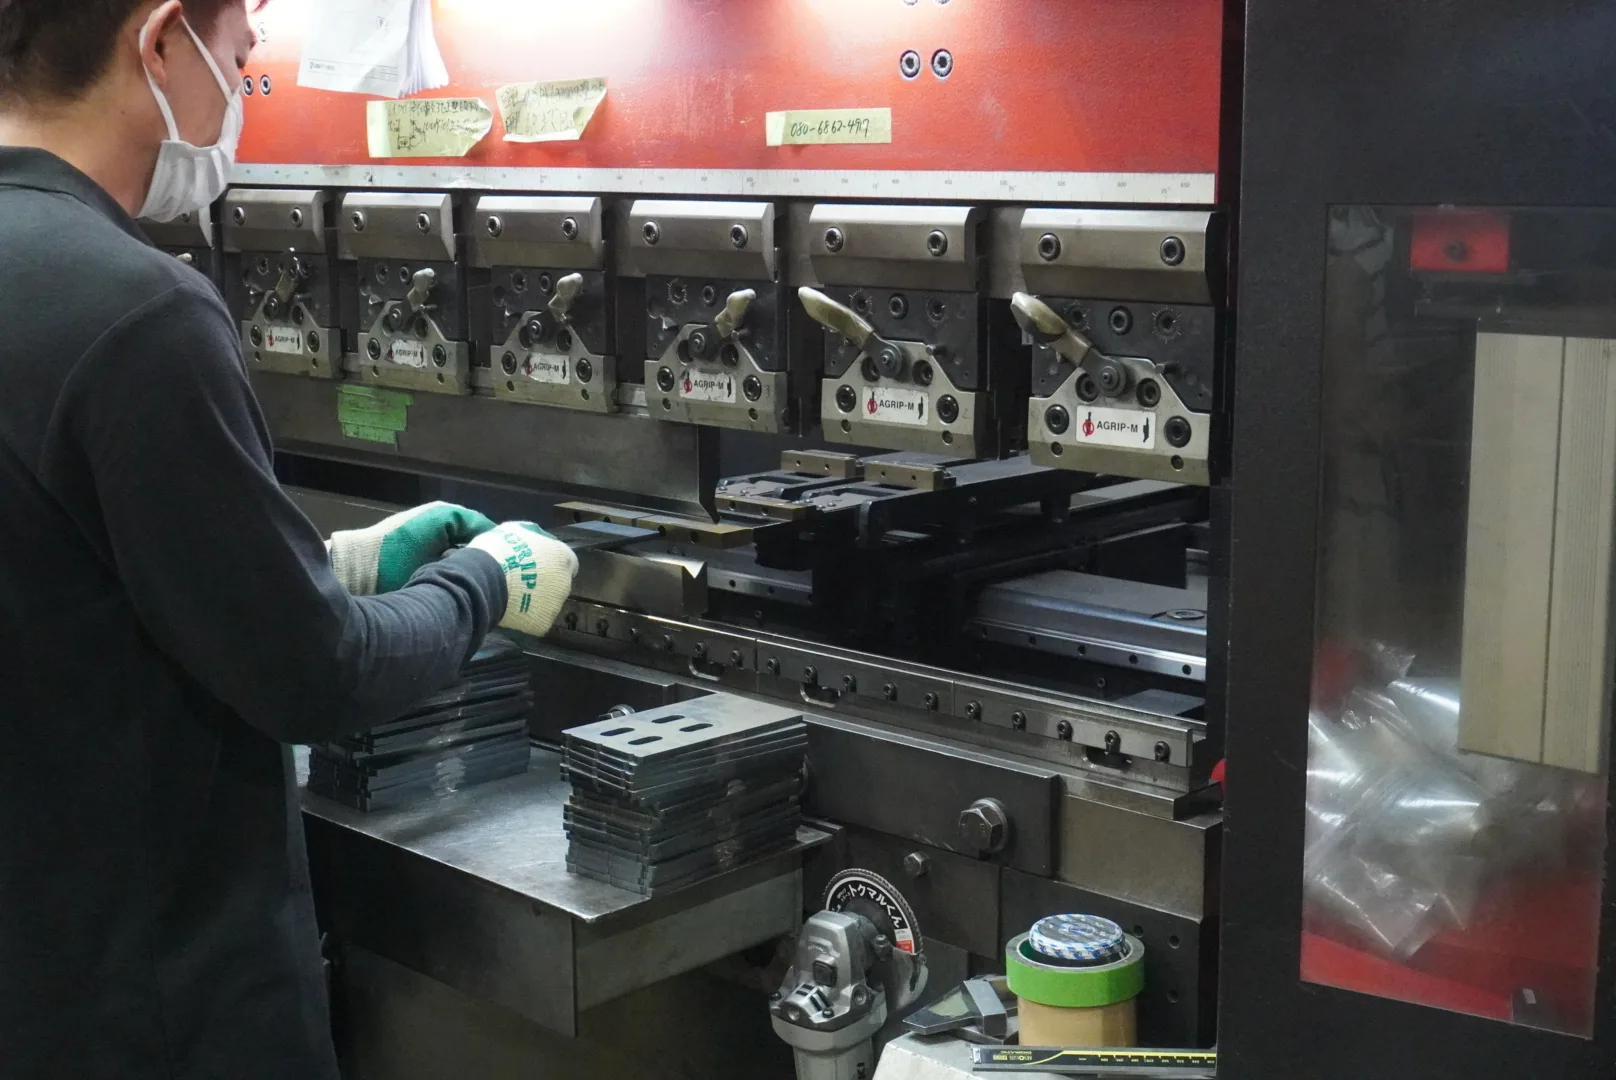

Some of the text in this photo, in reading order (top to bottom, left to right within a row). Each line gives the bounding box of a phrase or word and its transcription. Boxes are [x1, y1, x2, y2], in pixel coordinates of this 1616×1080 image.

[274, 335, 295, 344] AGRIP-M
[533, 363, 560, 372] AGRIP-M
[693, 380, 724, 390] AGRIP-M
[879, 399, 915, 411] AGRIP-M
[1096, 420, 1138, 433] AGRIP-M
[848, 883, 902, 929] トクマルくん
